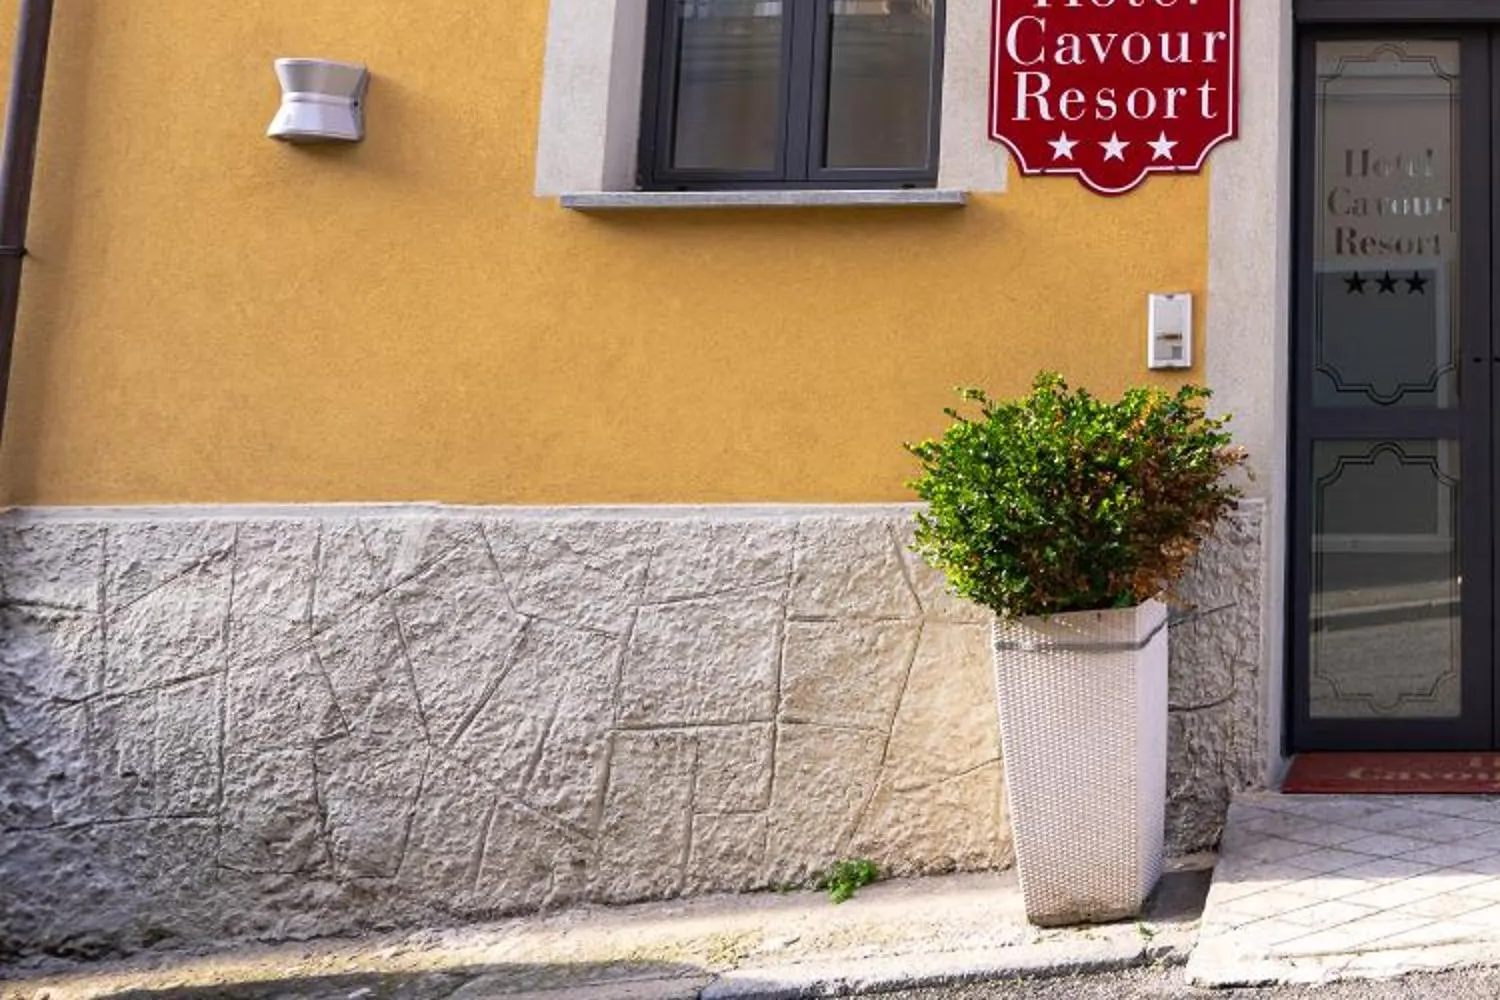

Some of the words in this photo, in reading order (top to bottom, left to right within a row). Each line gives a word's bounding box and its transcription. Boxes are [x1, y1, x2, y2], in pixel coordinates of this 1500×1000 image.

[1005, 15, 1228, 67] Cavour
[1011, 71, 1218, 122] Resort
[1335, 227, 1441, 256] Resort
